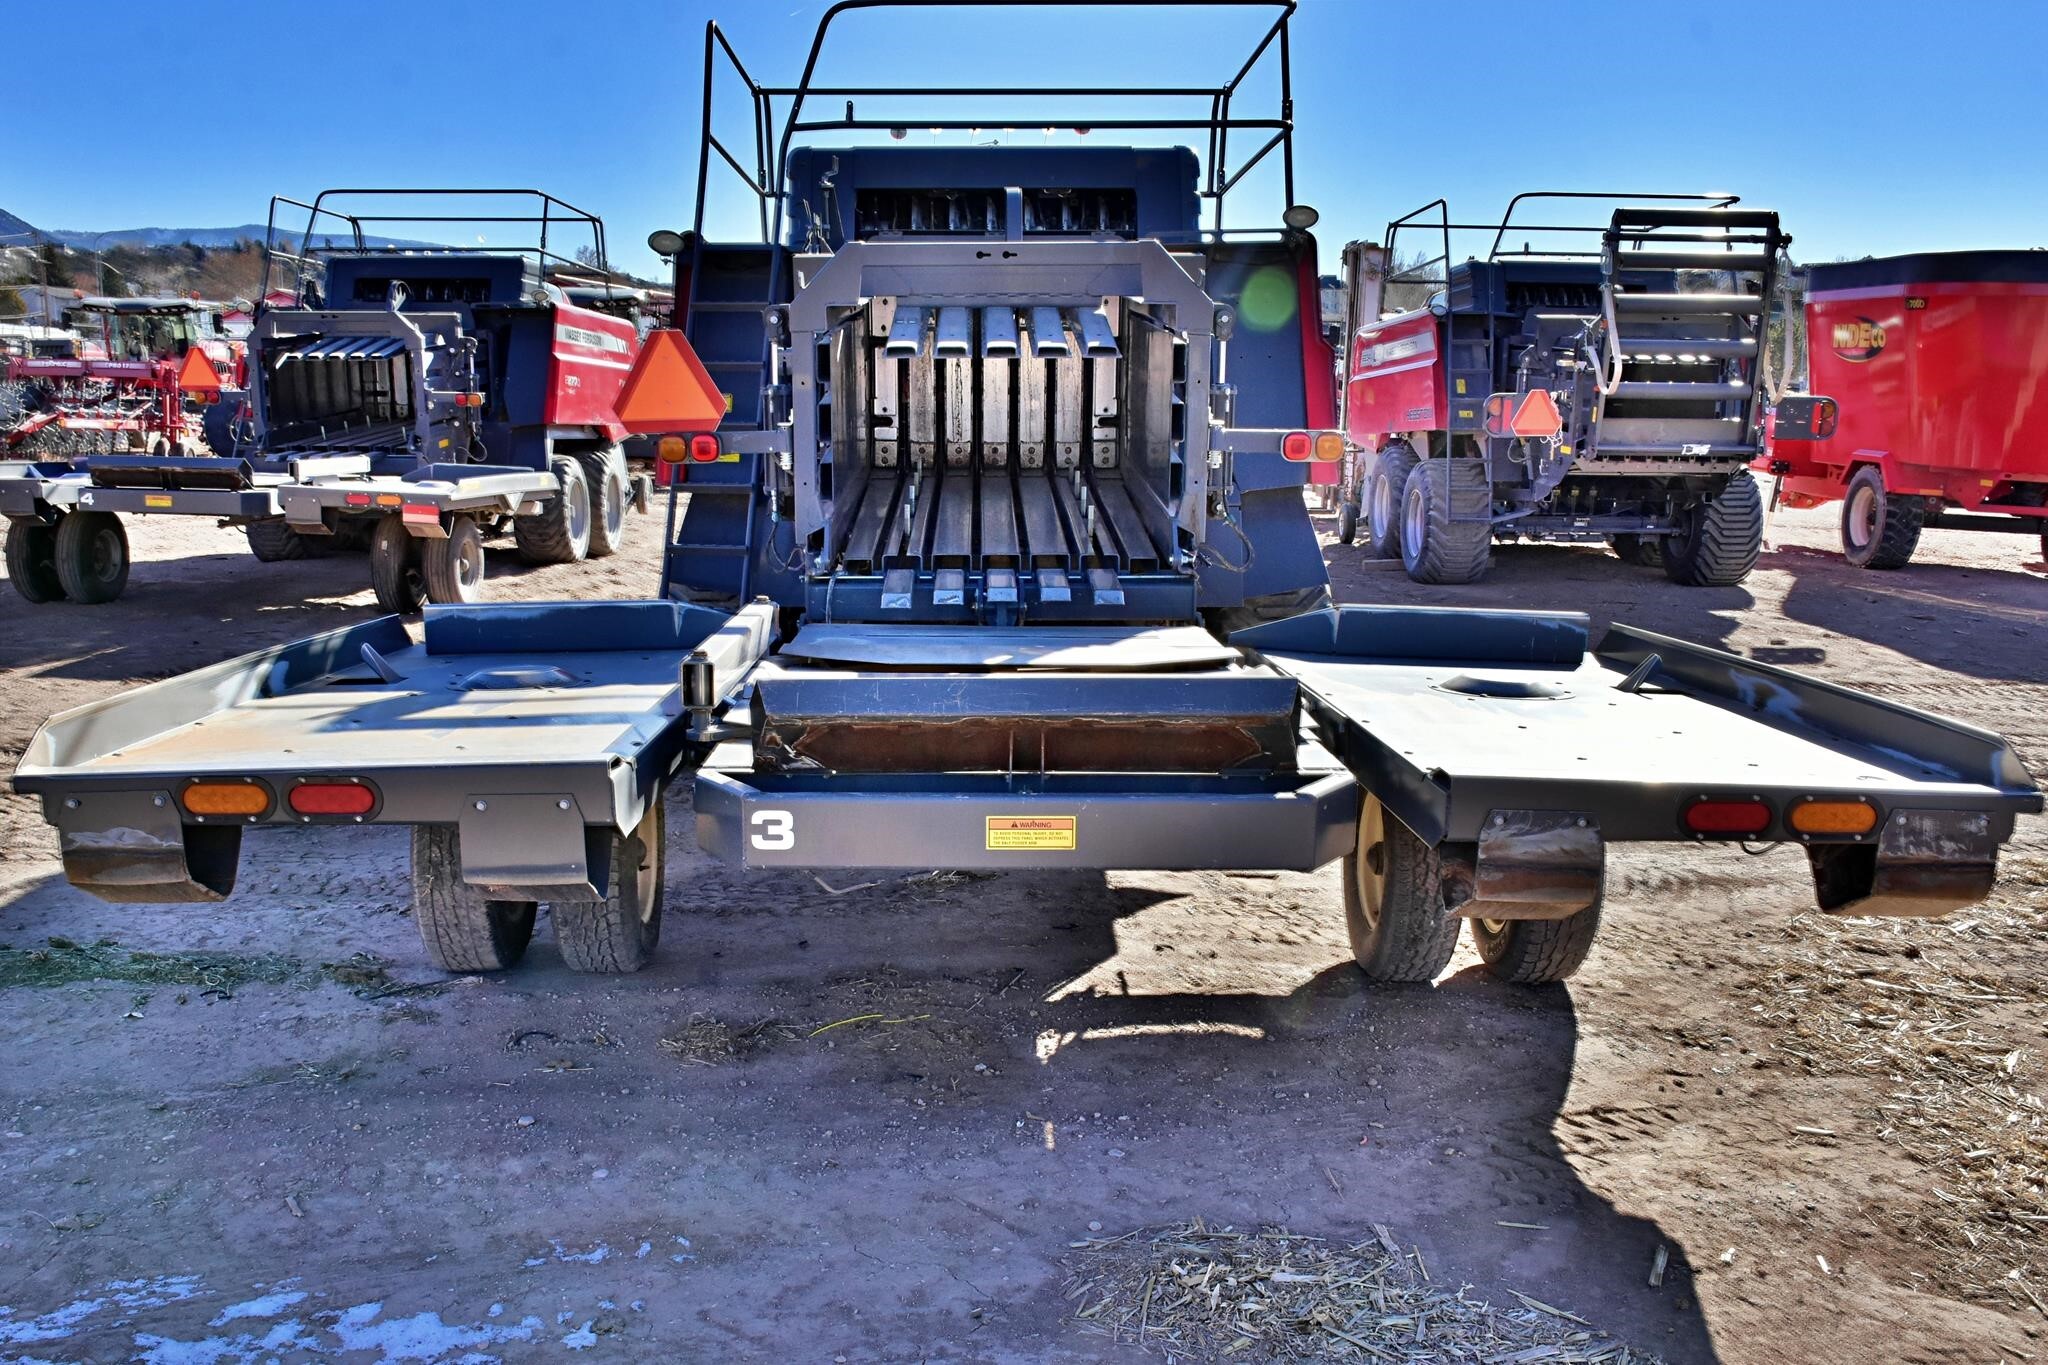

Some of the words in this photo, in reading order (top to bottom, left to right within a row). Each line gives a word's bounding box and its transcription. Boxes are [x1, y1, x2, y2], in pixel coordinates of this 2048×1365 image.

[80, 492, 95, 506] 4
[751, 810, 795, 850] 3
[1019, 821, 1052, 829] WARNING
